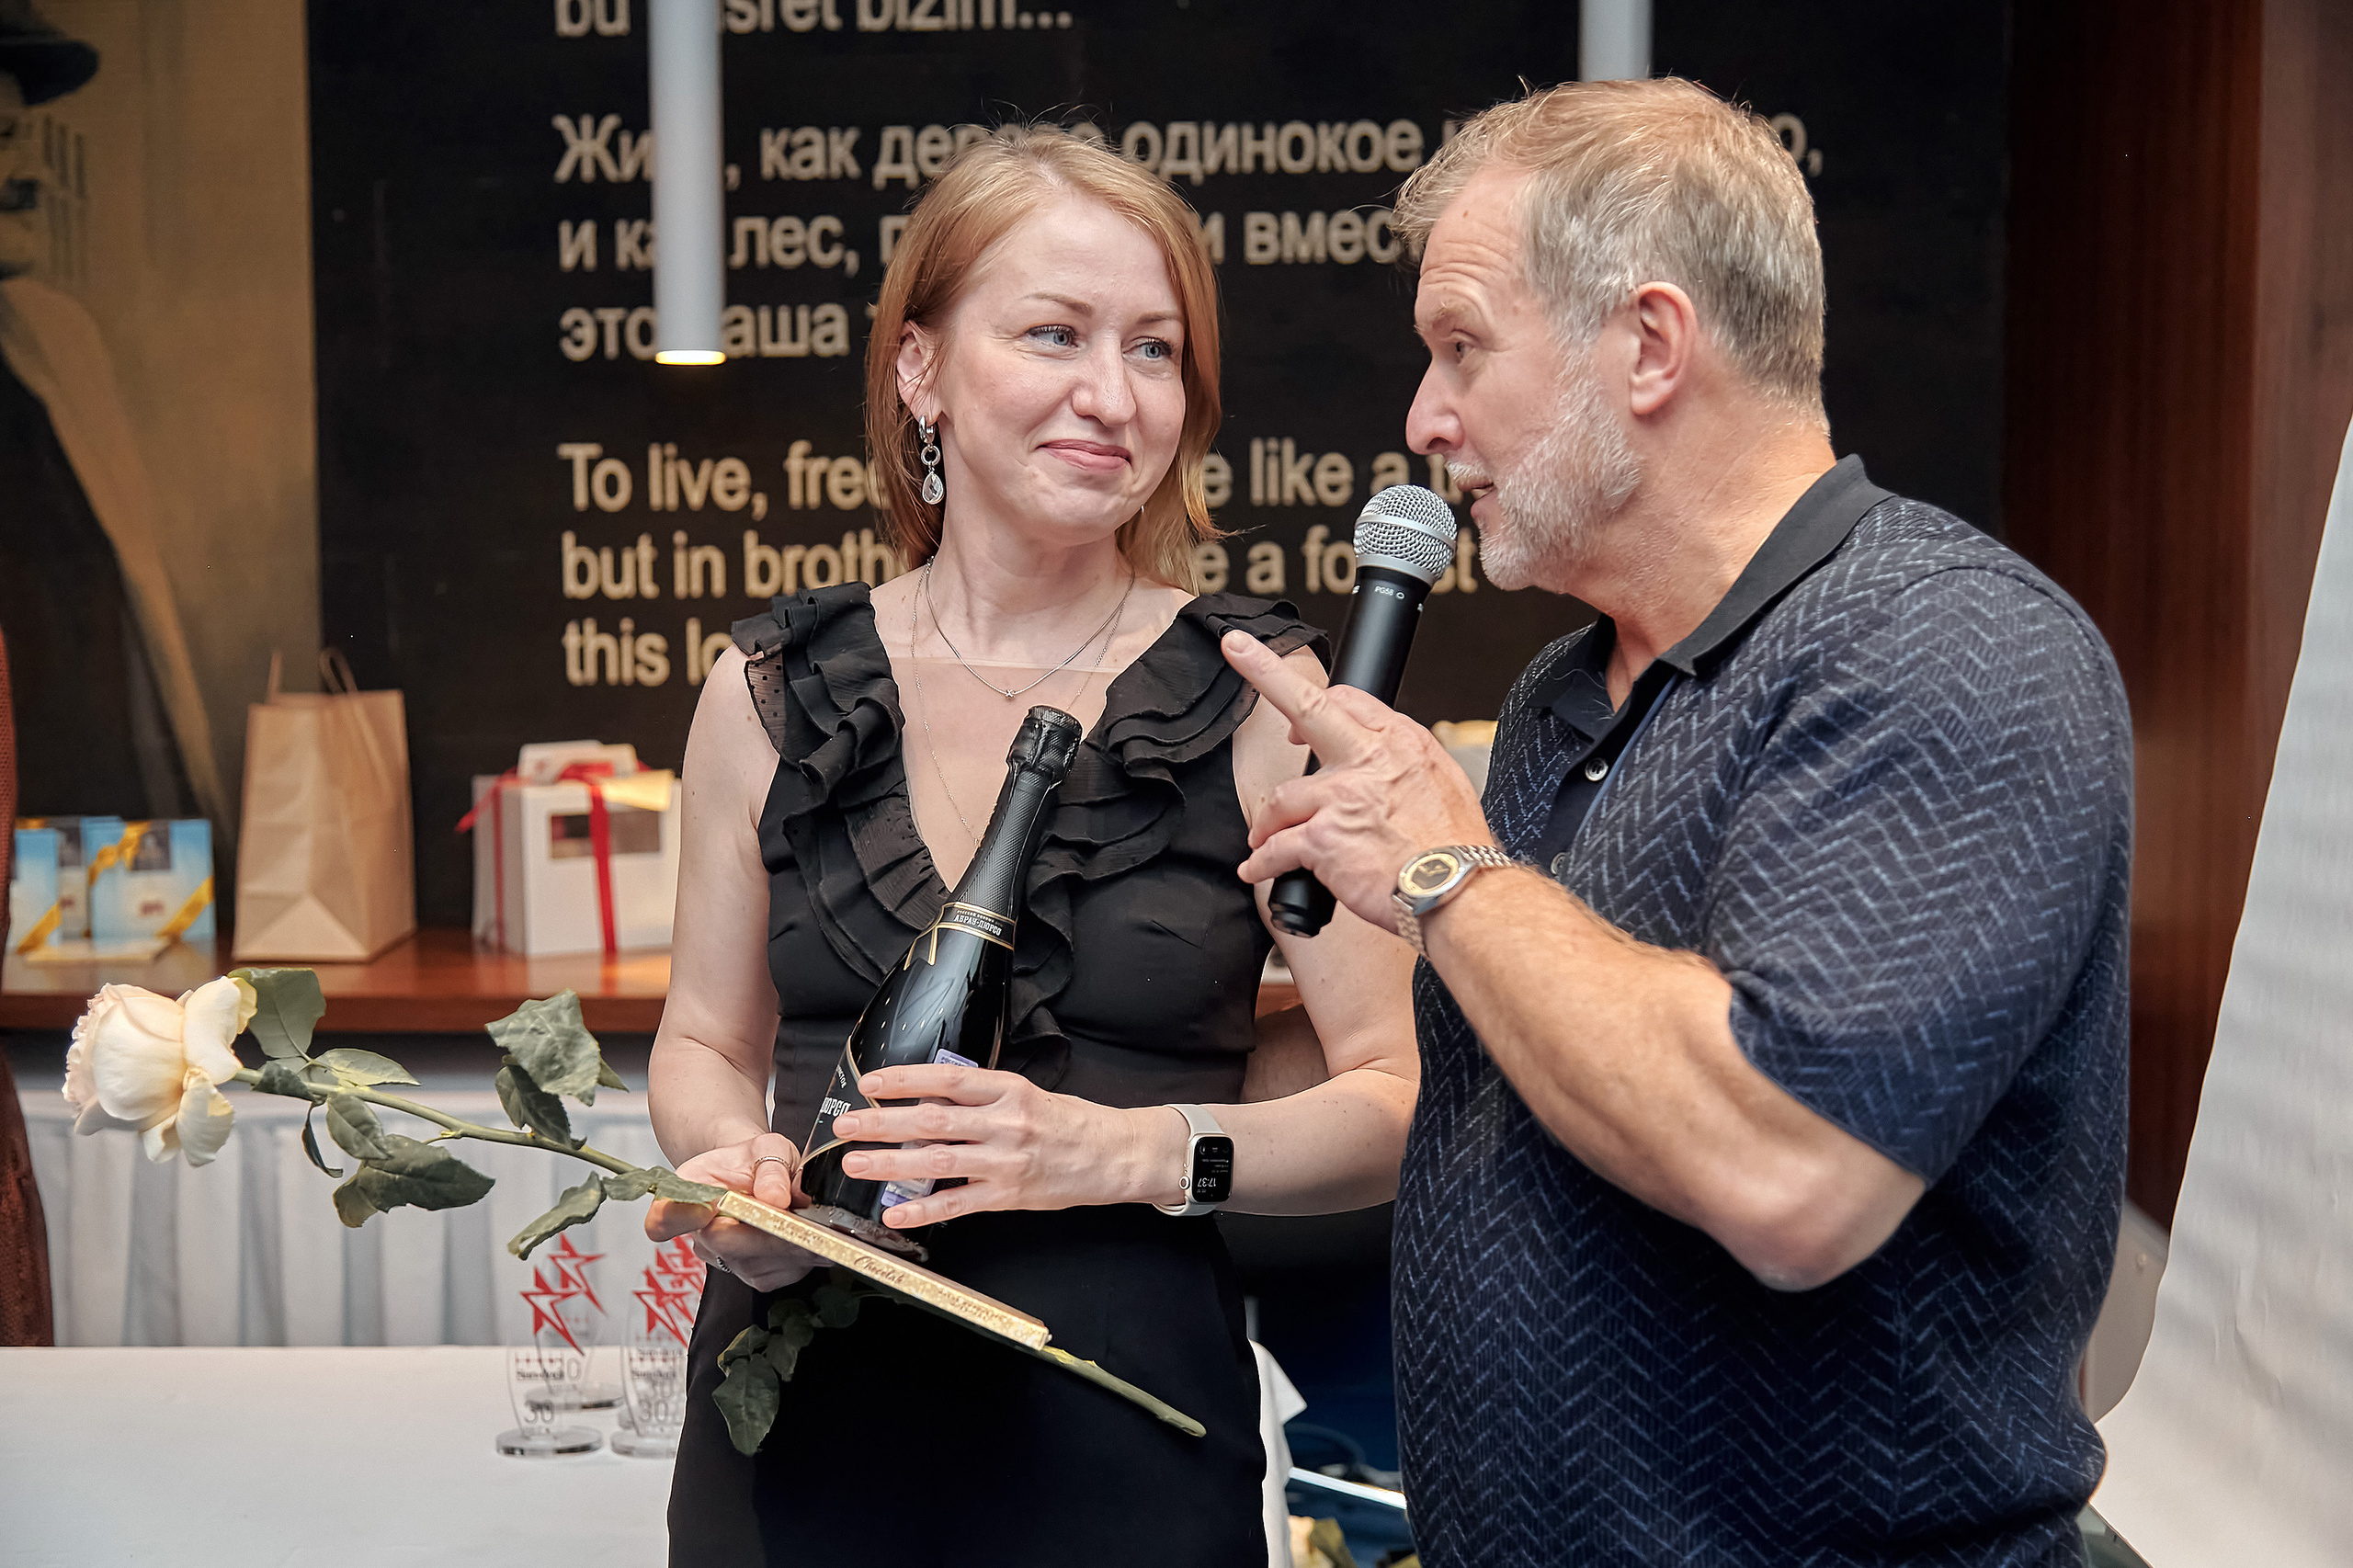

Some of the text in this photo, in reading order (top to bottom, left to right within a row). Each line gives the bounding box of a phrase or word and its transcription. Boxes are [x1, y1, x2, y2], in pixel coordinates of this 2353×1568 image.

[759, 125, 861, 181] как
[1121, 119, 1424, 185] одинокое
[558, 220, 597, 272] и
[727, 215, 860, 278] лес,
[1245, 209, 1421, 266] вмес
[722, 302, 850, 358] аша
[556, 442, 634, 513] To
[647, 442, 769, 521] live,
[1248, 437, 1355, 507] like
[561, 529, 661, 599] but
[672, 529, 727, 599] in
[1245, 540, 1287, 596] a
[562, 617, 672, 687] this
[1197, 1177, 1217, 1187] 17:37
